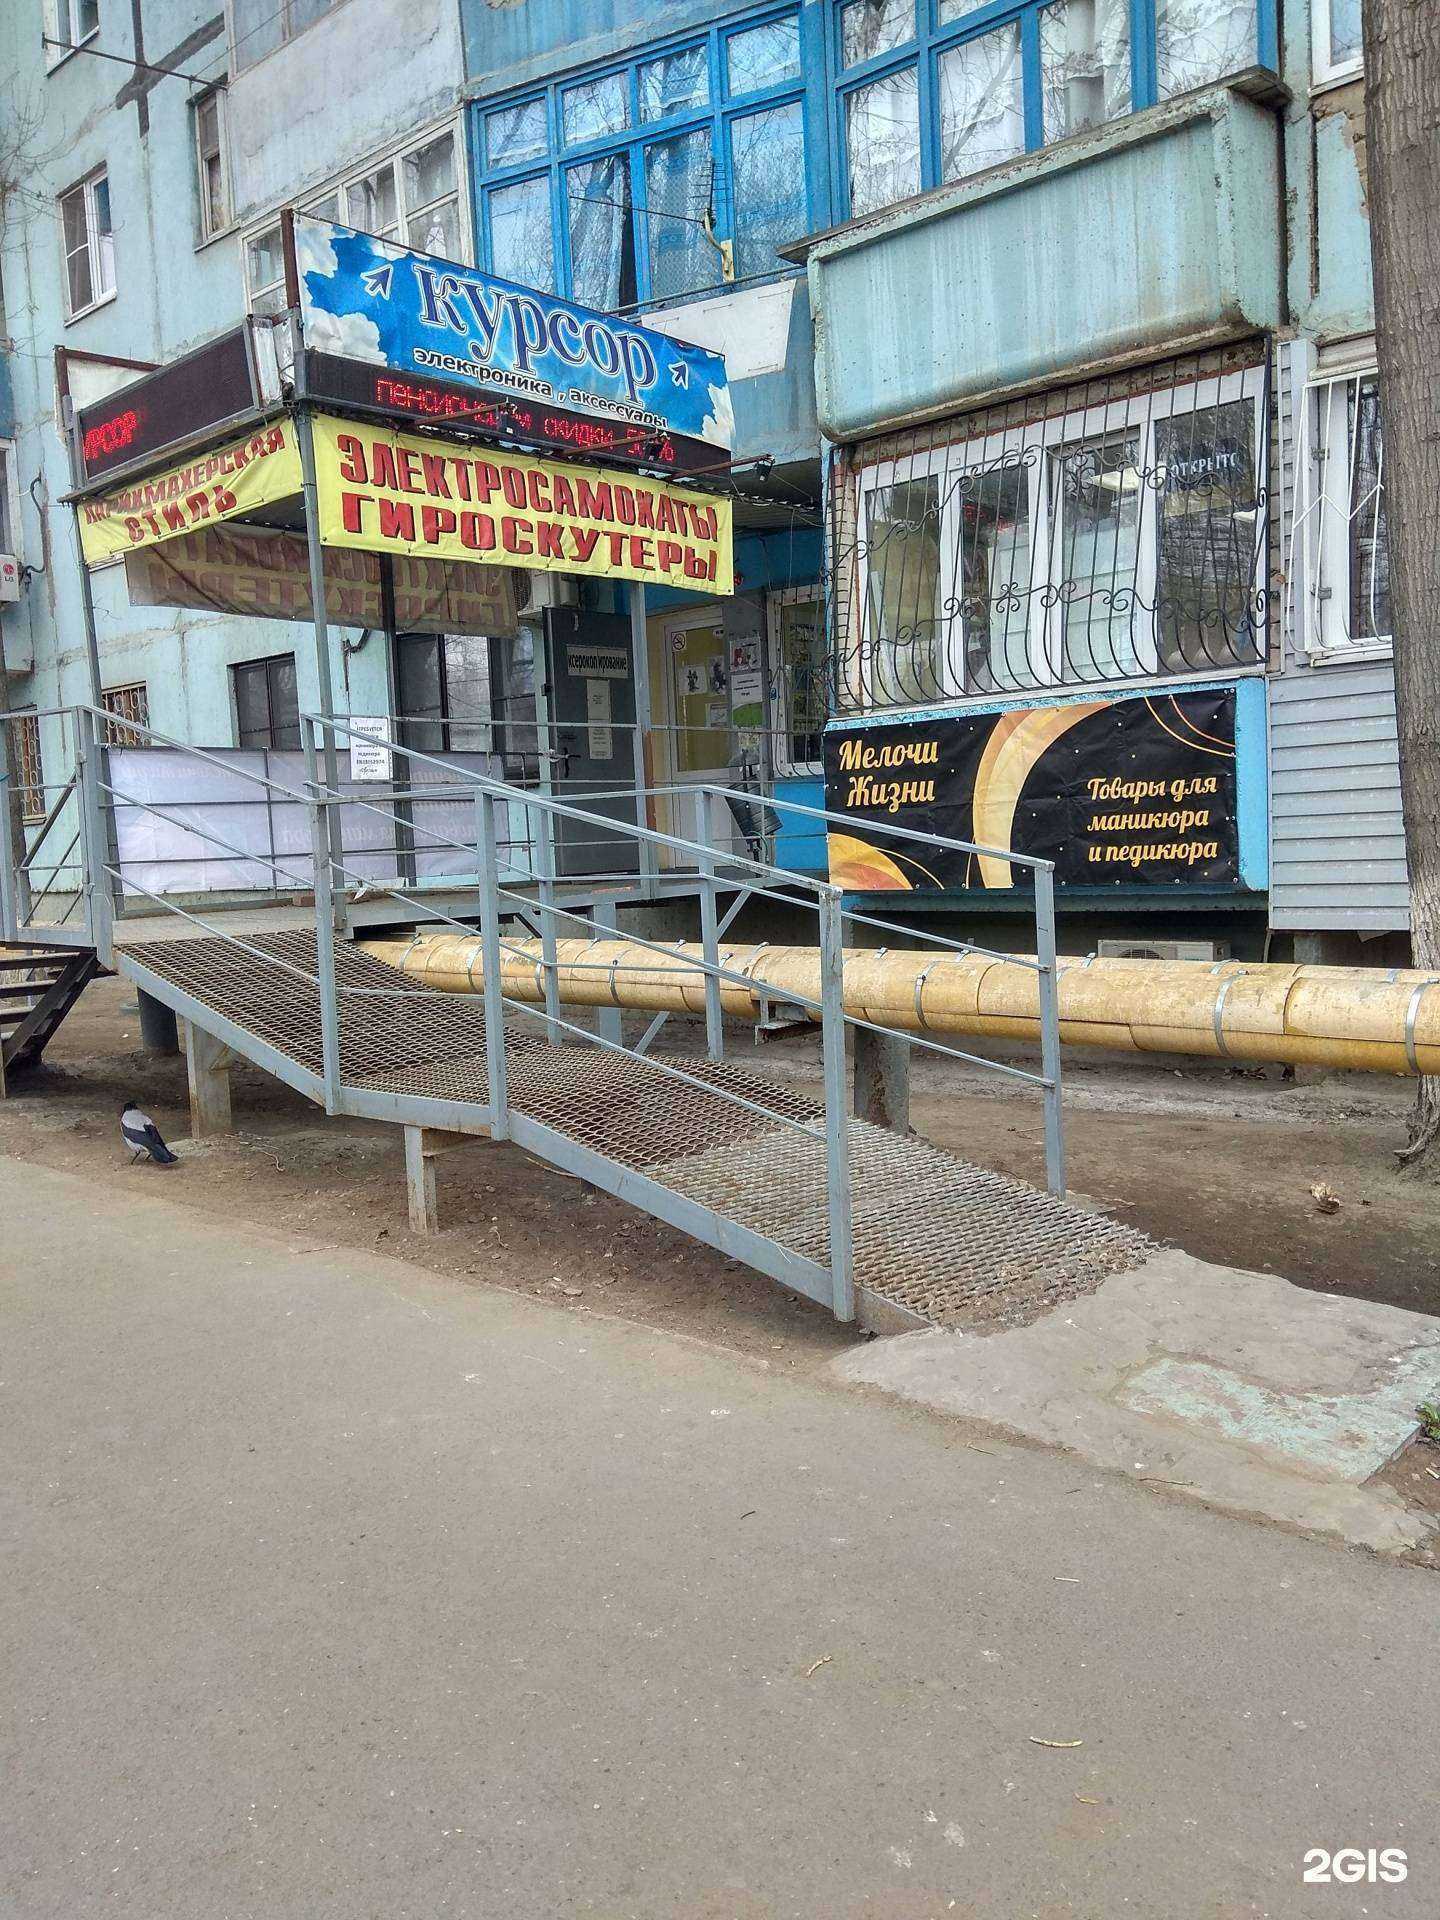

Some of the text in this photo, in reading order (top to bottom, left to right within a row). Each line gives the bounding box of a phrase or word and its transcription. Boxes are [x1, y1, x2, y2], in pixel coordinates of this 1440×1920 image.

[413, 347, 552, 397] электроника
[337, 433, 719, 543] ЭЛЕКТРОСАМОКАТЫ
[124, 484, 238, 543] СТИЛЬ
[341, 493, 718, 583] ГИРОСКУТЕРЫ
[839, 740, 939, 771] Мелочи
[846, 775, 935, 813] Жизни
[1087, 776, 1217, 804] Товары для
[1087, 810, 1209, 834] маникюра
[1088, 841, 1218, 867] и педикюра
